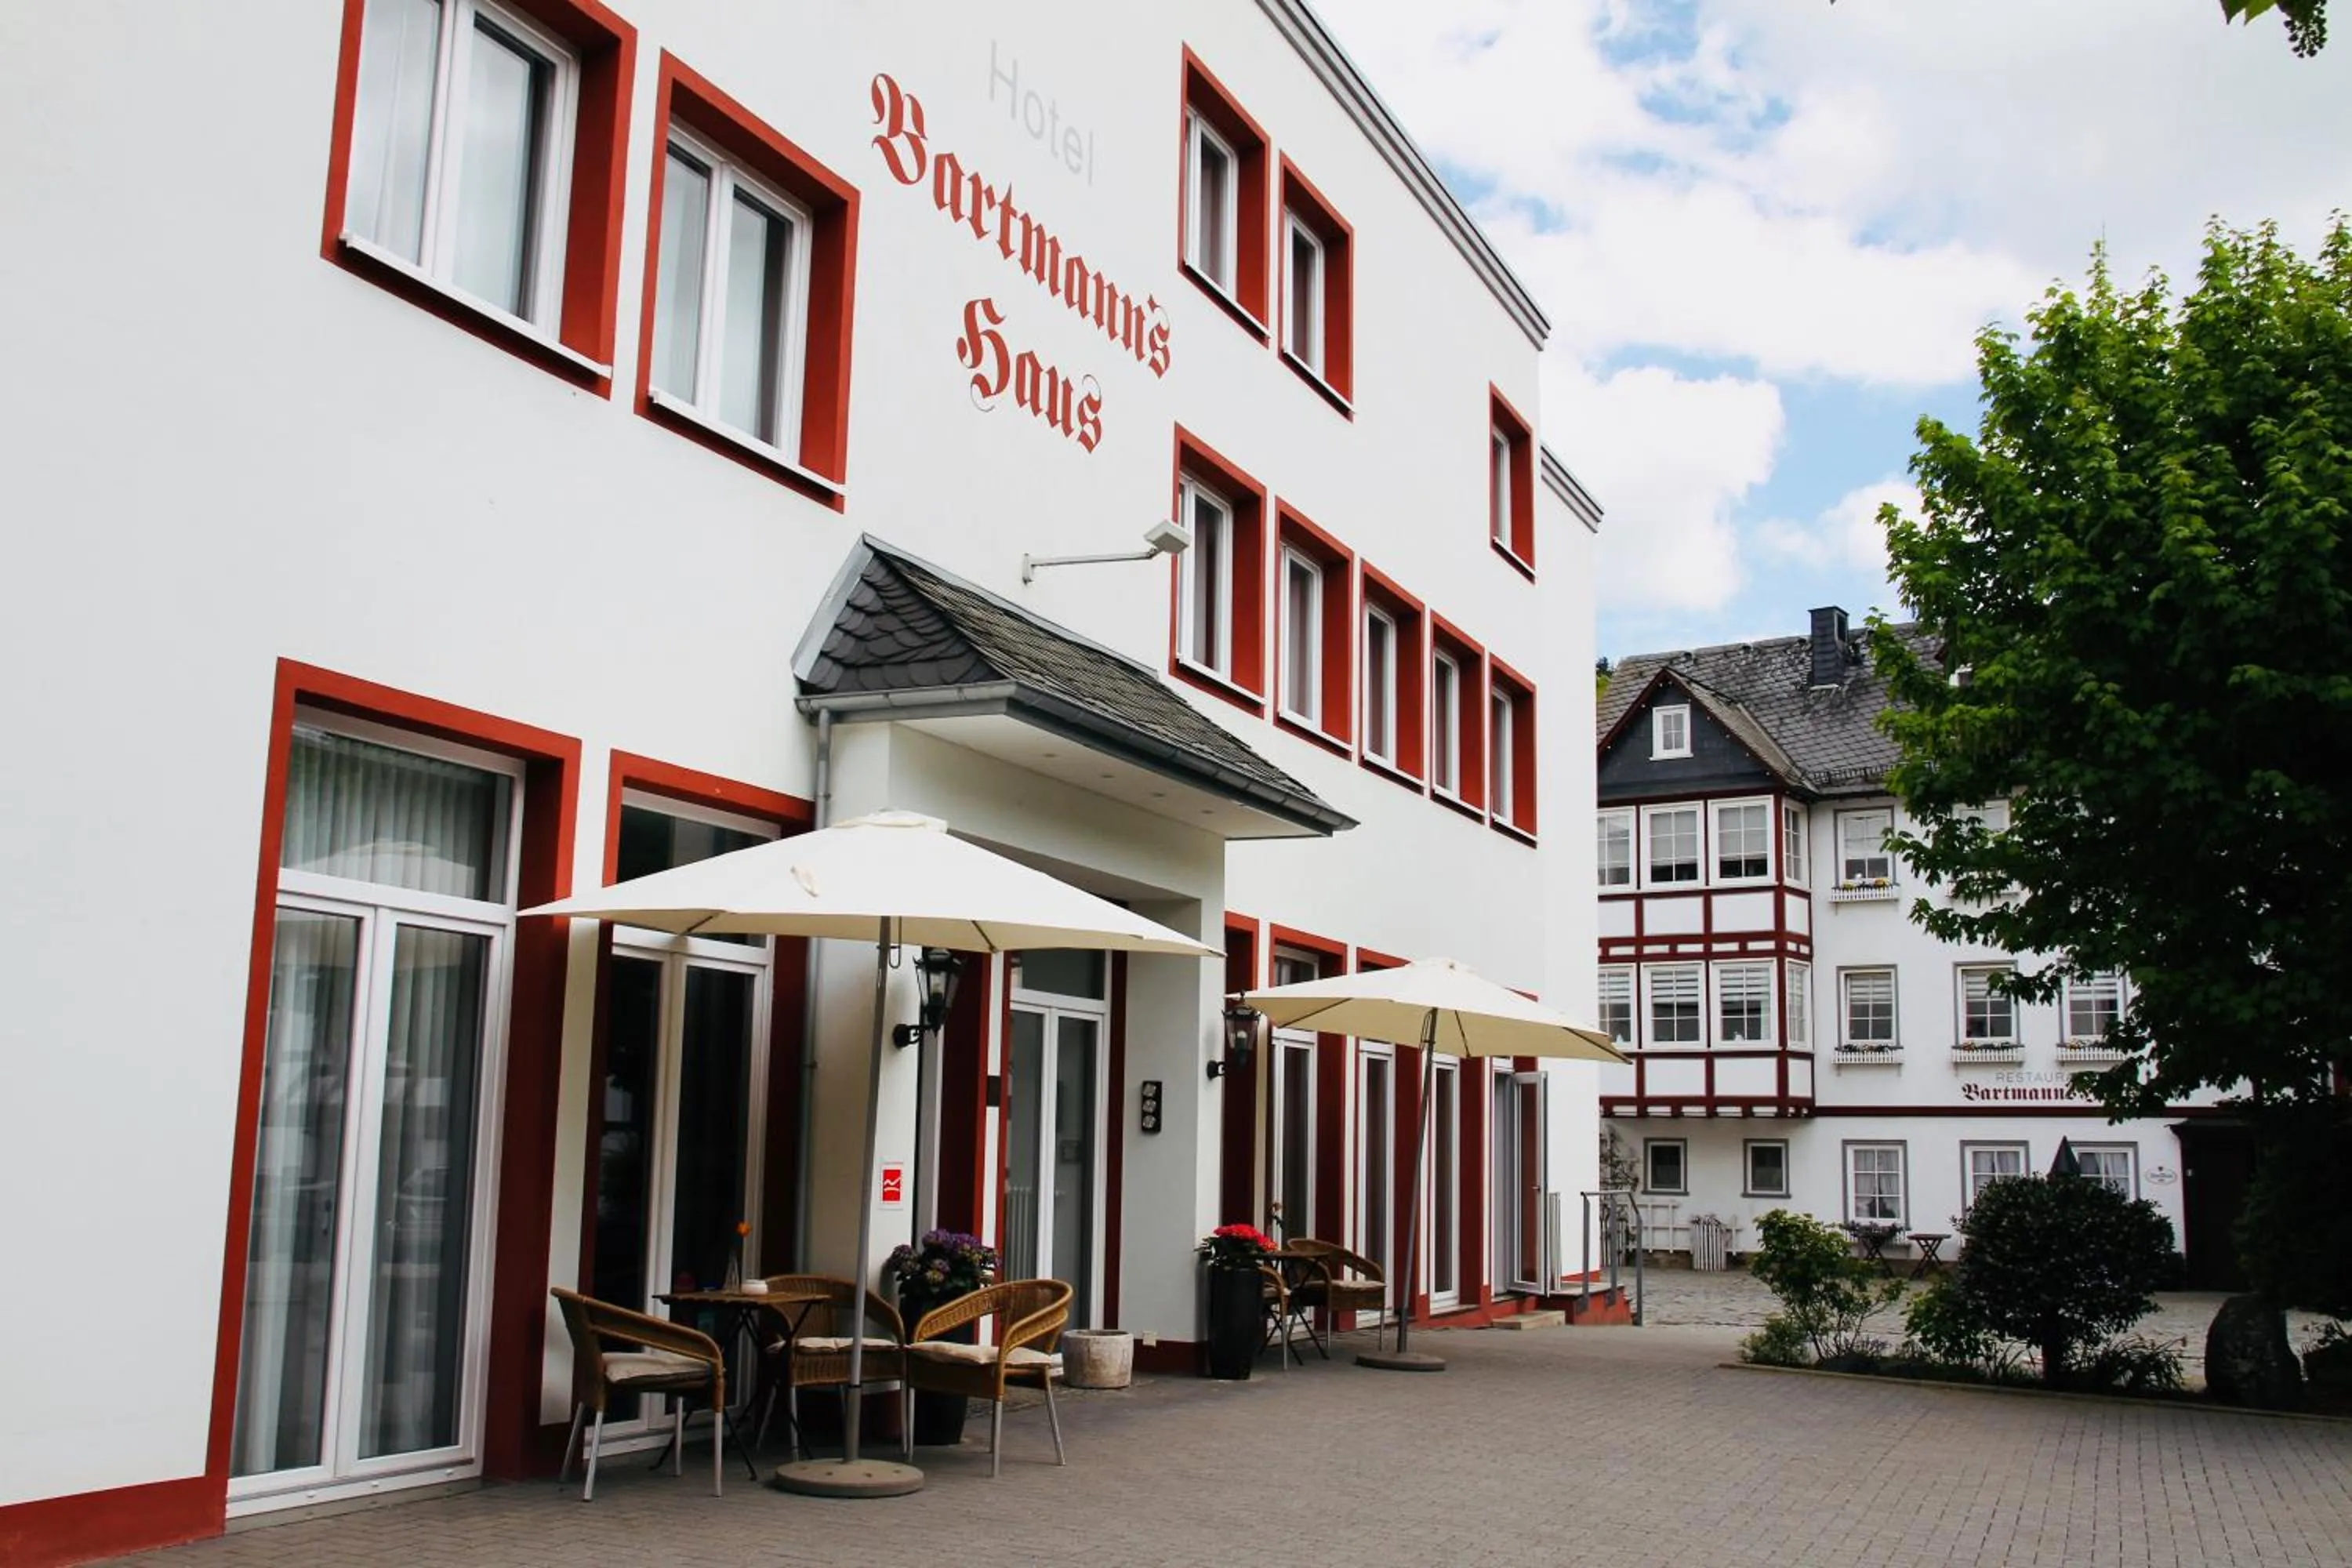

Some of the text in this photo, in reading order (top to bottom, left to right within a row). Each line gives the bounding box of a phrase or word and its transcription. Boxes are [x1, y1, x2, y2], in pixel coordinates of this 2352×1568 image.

[989, 40, 1094, 186] Hotel
[956, 298, 1102, 452] Haus
[1995, 1072, 2072, 1082] RESTAUR
